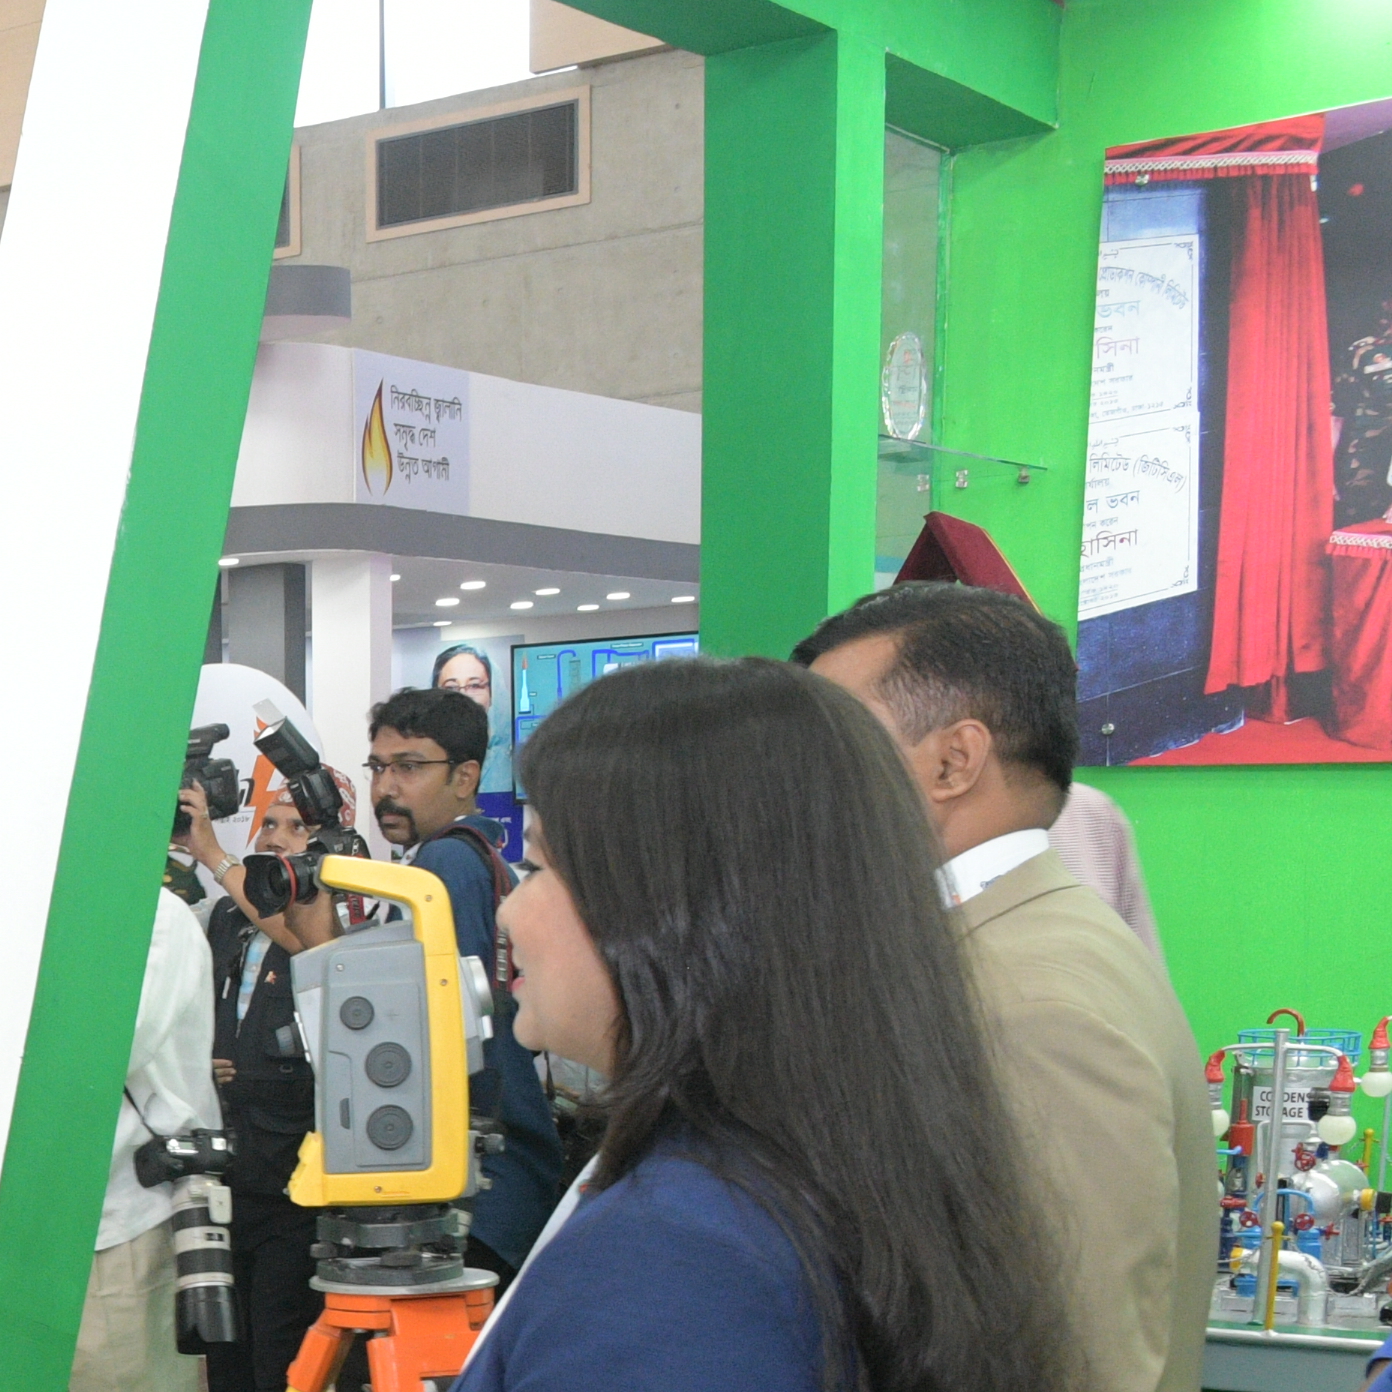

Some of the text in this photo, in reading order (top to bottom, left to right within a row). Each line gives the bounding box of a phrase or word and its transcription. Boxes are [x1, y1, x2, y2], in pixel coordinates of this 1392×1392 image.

[1096, 300, 1141, 318] ভবন
[390, 385, 462, 424] নিরবচ্ছিন্ন জ্বালানি
[393, 423, 436, 451] সমৃদ্ধ দেশ
[397, 450, 449, 484] উন্নত আগামী
[1106, 490, 1140, 509] ভবন
[1255, 1105, 1304, 1118] STOAGE
